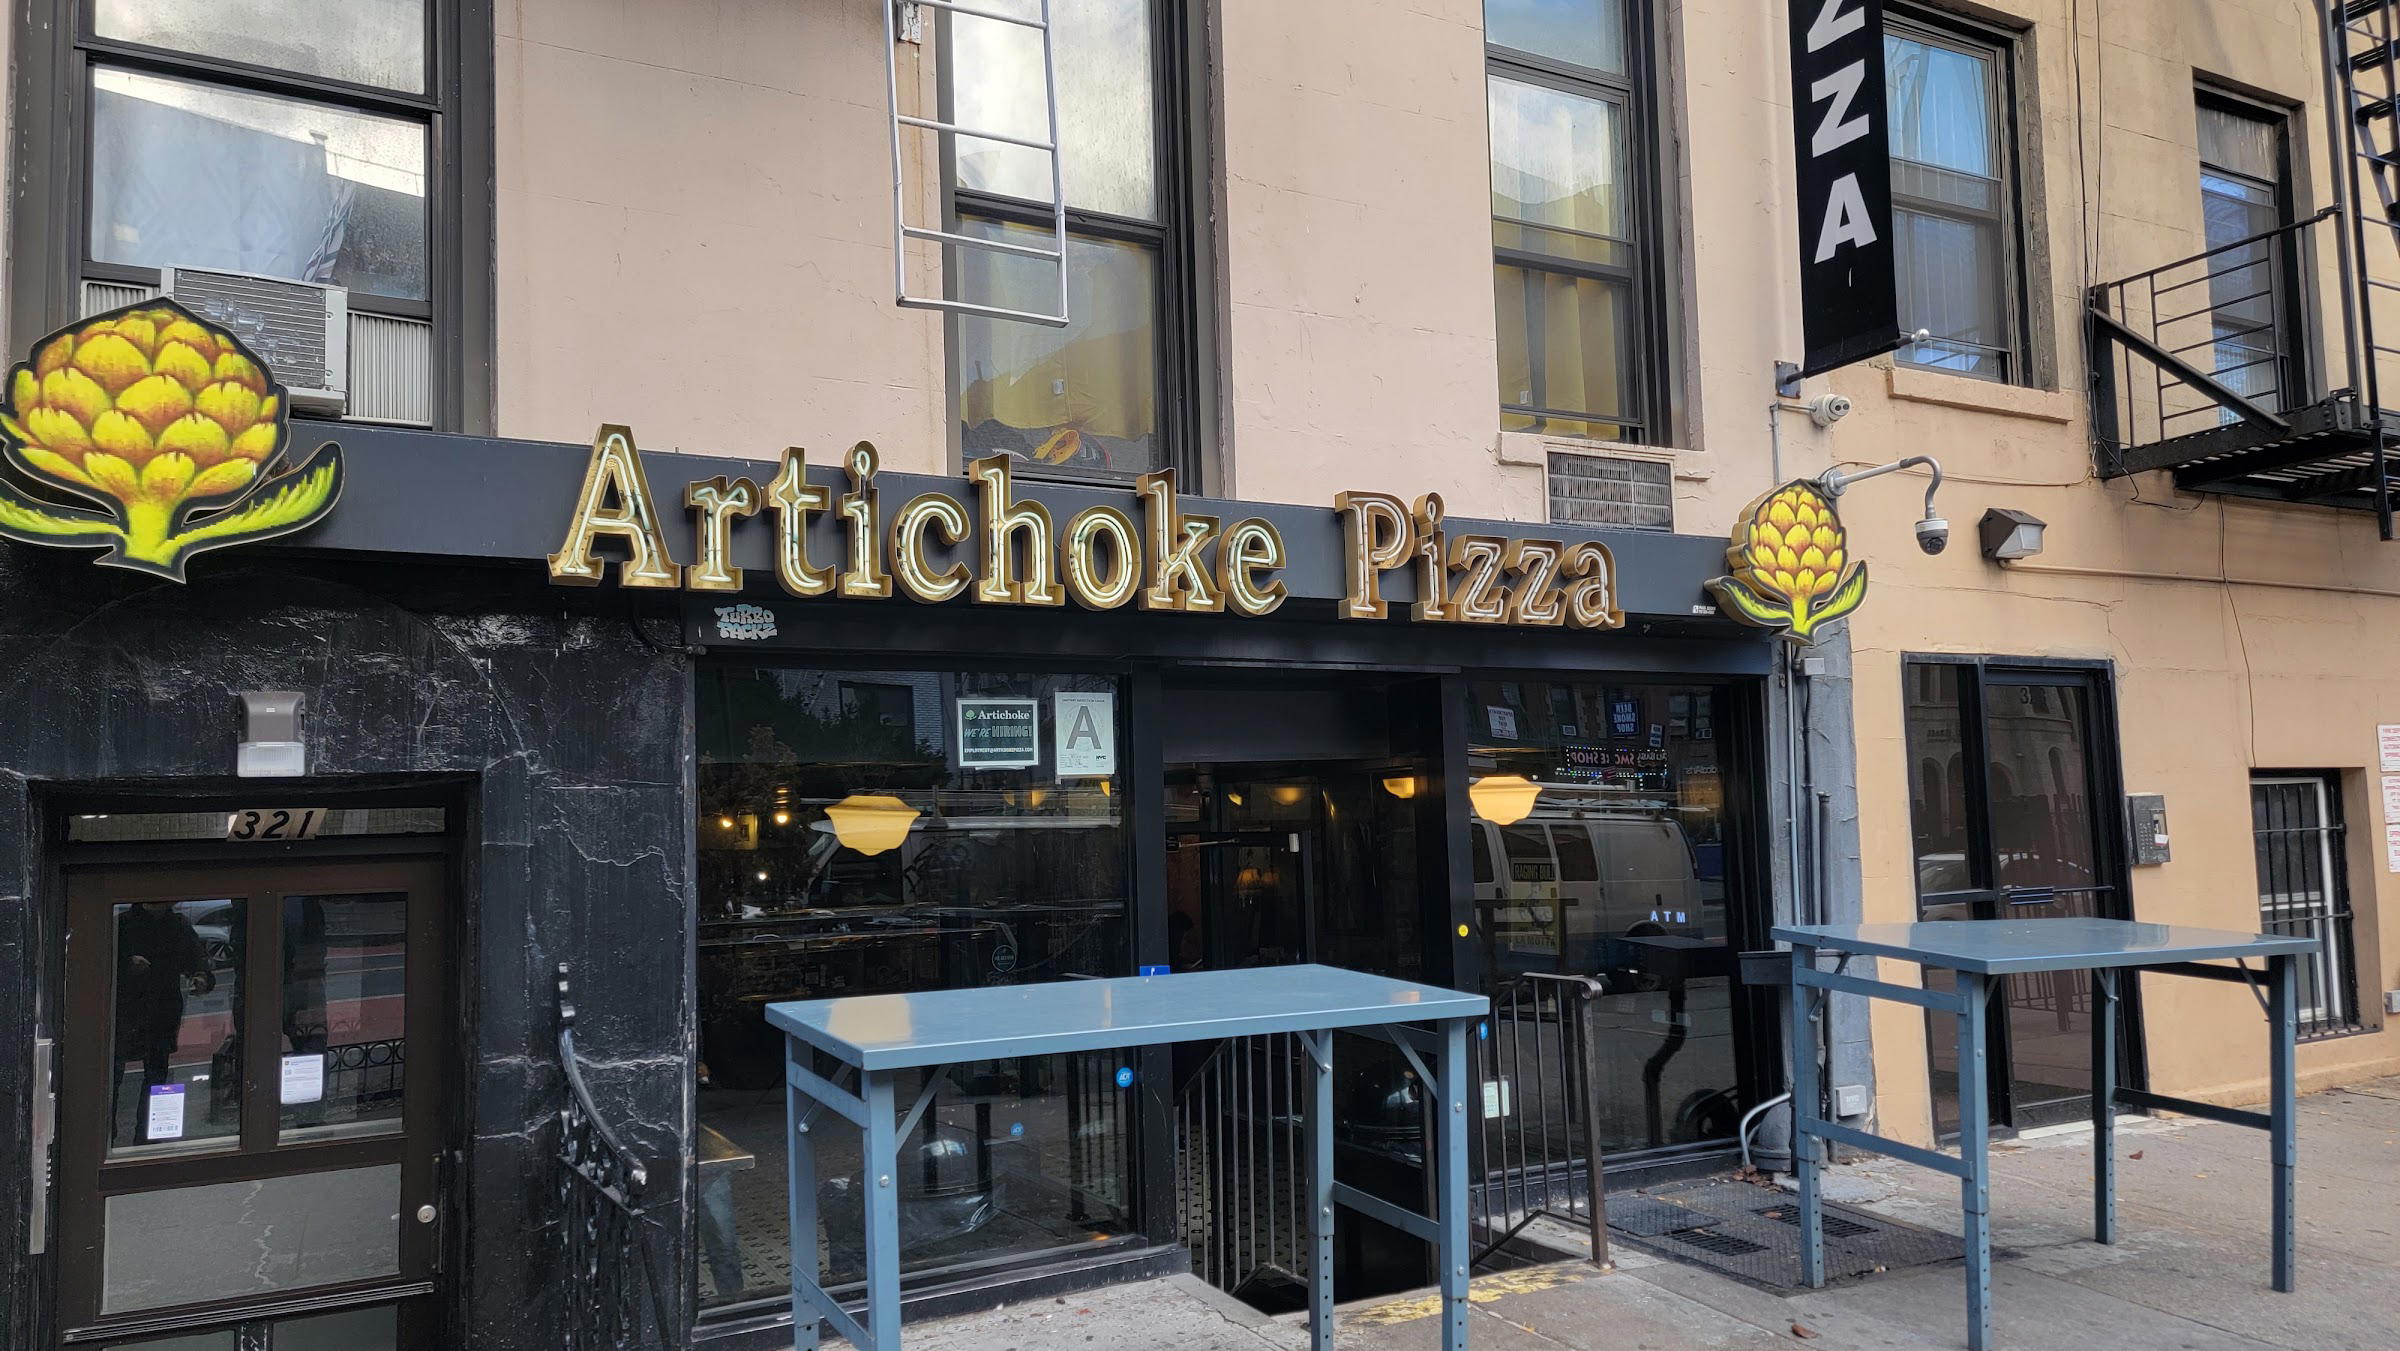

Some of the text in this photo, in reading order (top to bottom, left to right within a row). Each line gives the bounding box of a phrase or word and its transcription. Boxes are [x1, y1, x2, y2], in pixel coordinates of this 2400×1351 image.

[547, 424, 1626, 631] Artichoke Pizza
[714, 604, 775, 624] TURBO
[978, 709, 1030, 720] Artichoke
[964, 725, 1033, 738] WE'RE HIRING!
[1066, 705, 1102, 750] A
[234, 810, 314, 839] 321
[1650, 910, 1686, 923] ATM
